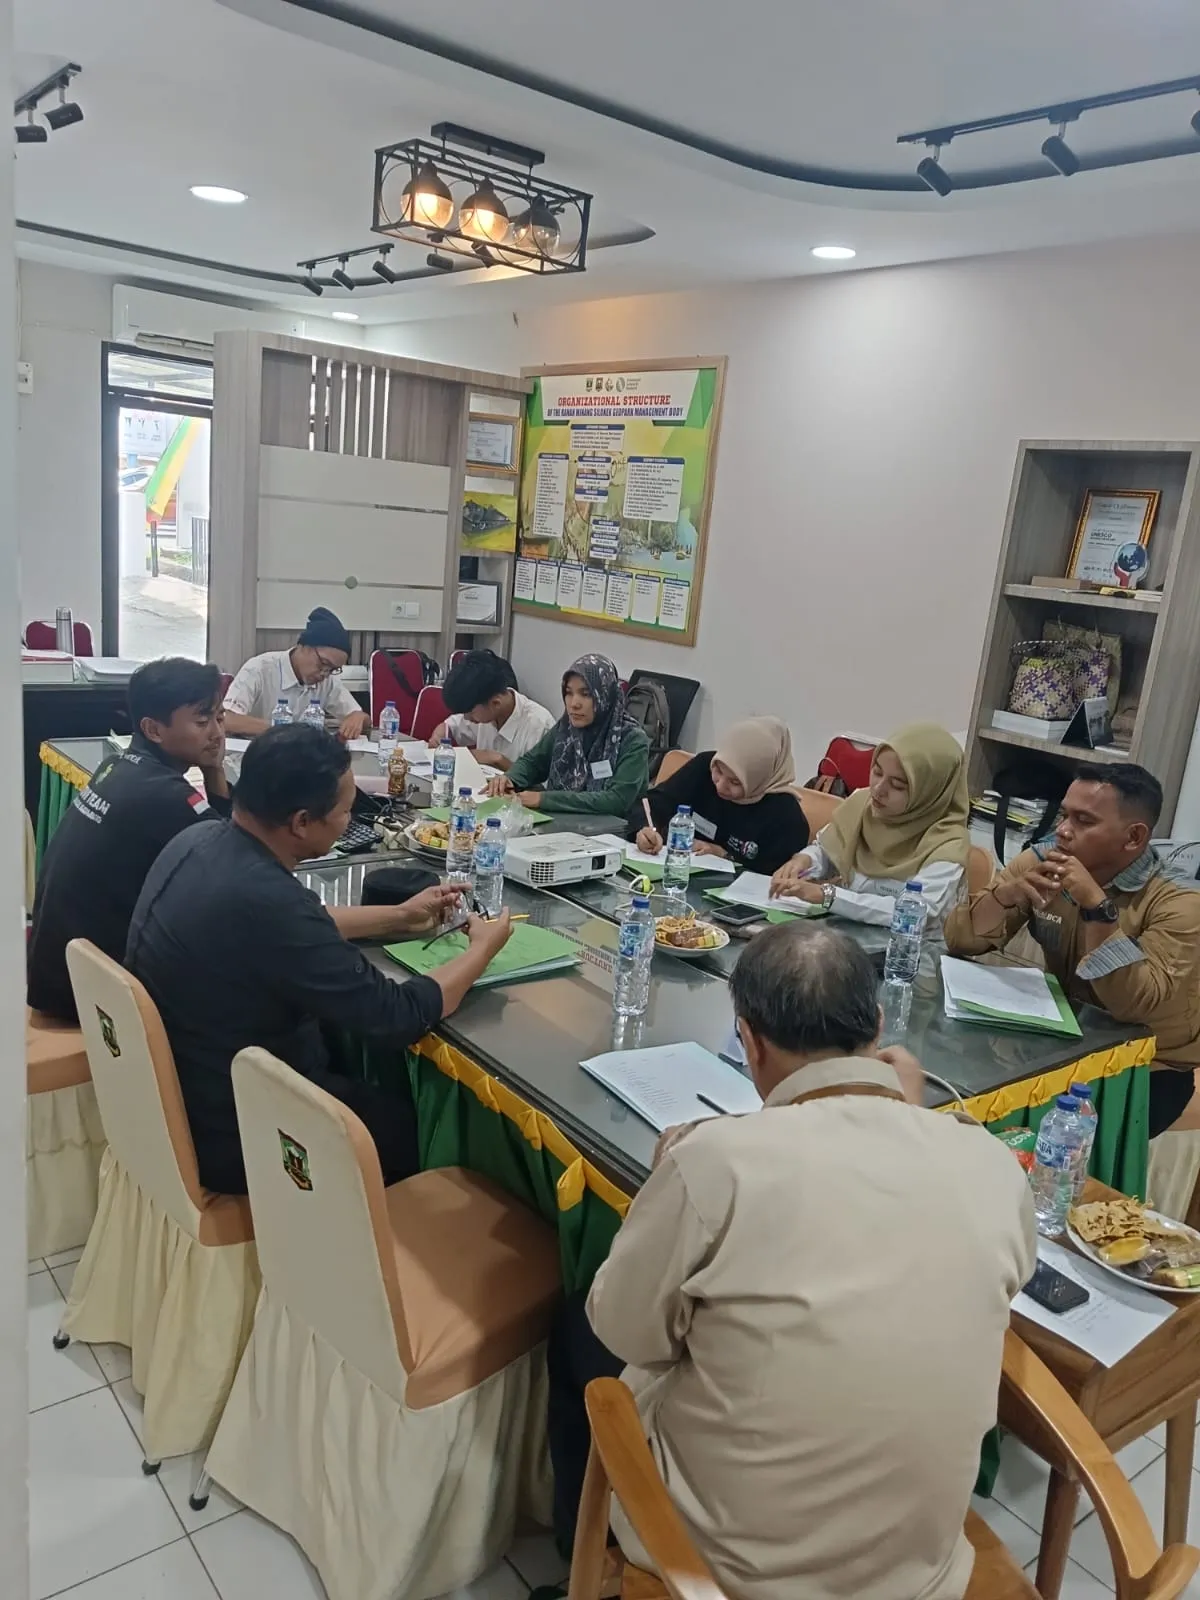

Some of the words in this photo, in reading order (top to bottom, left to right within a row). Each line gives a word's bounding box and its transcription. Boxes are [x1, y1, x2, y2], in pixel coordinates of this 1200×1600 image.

[558, 395, 621, 407] ORGANIZATIONAL
[623, 394, 671, 406] STRUCTURE
[553, 408, 561, 417] THE
[561, 408, 575, 417] RANAH
[575, 408, 593, 417] MINANG
[612, 407, 634, 417] GEOPARK
[634, 407, 668, 417] MANAGEMENT
[668, 407, 684, 417] BODY
[88, 788, 111, 815] TEAM
